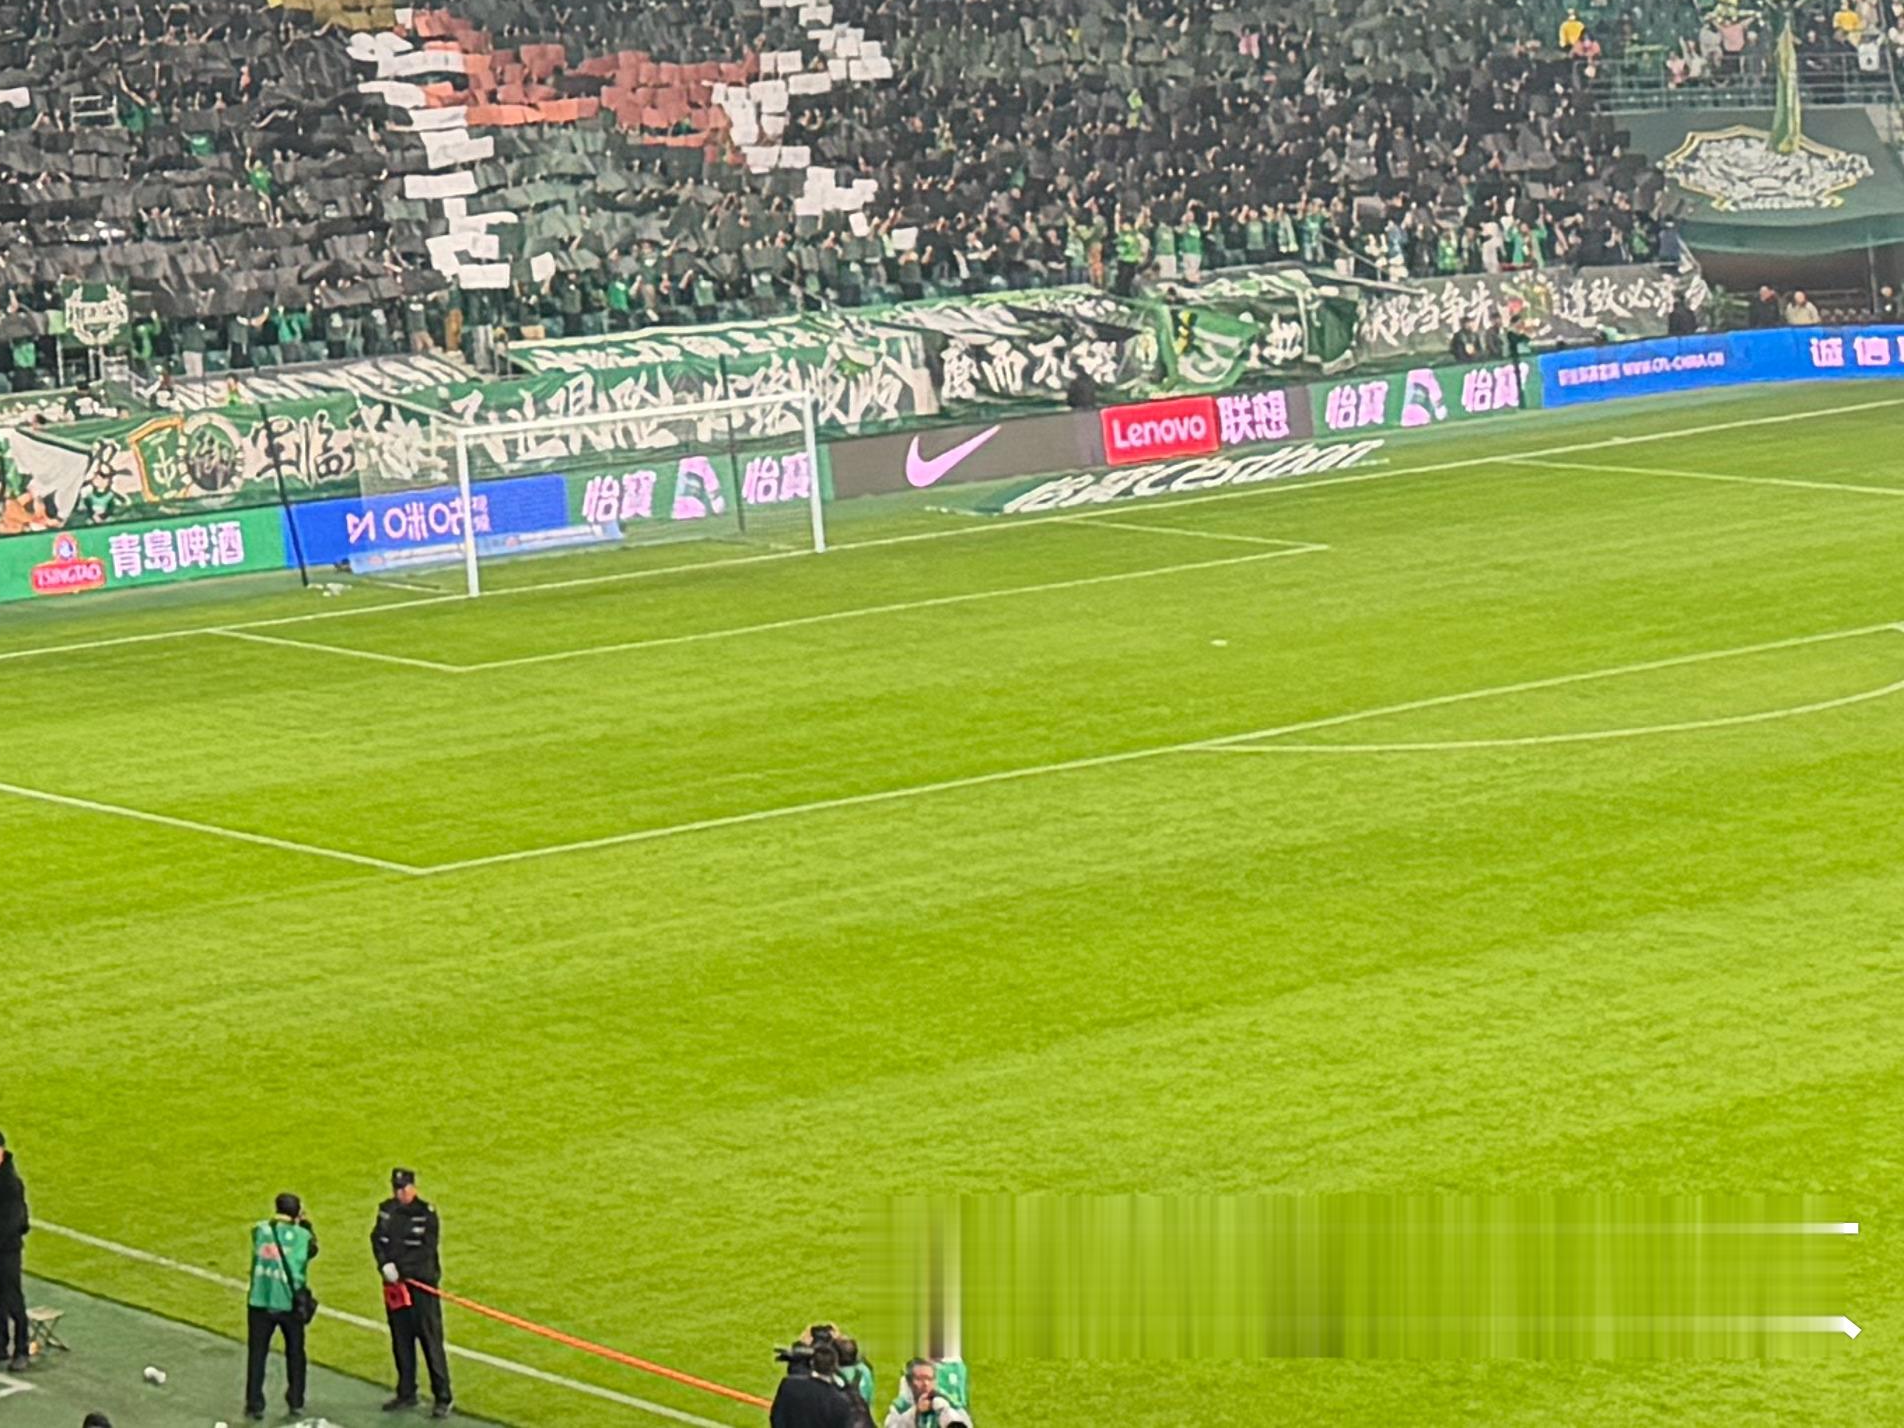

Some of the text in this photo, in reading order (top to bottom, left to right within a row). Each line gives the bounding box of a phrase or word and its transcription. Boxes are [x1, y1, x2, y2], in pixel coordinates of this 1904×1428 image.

[1112, 389, 1290, 449] Lenovo 联想
[108, 520, 245, 580] 青岛啤酒
